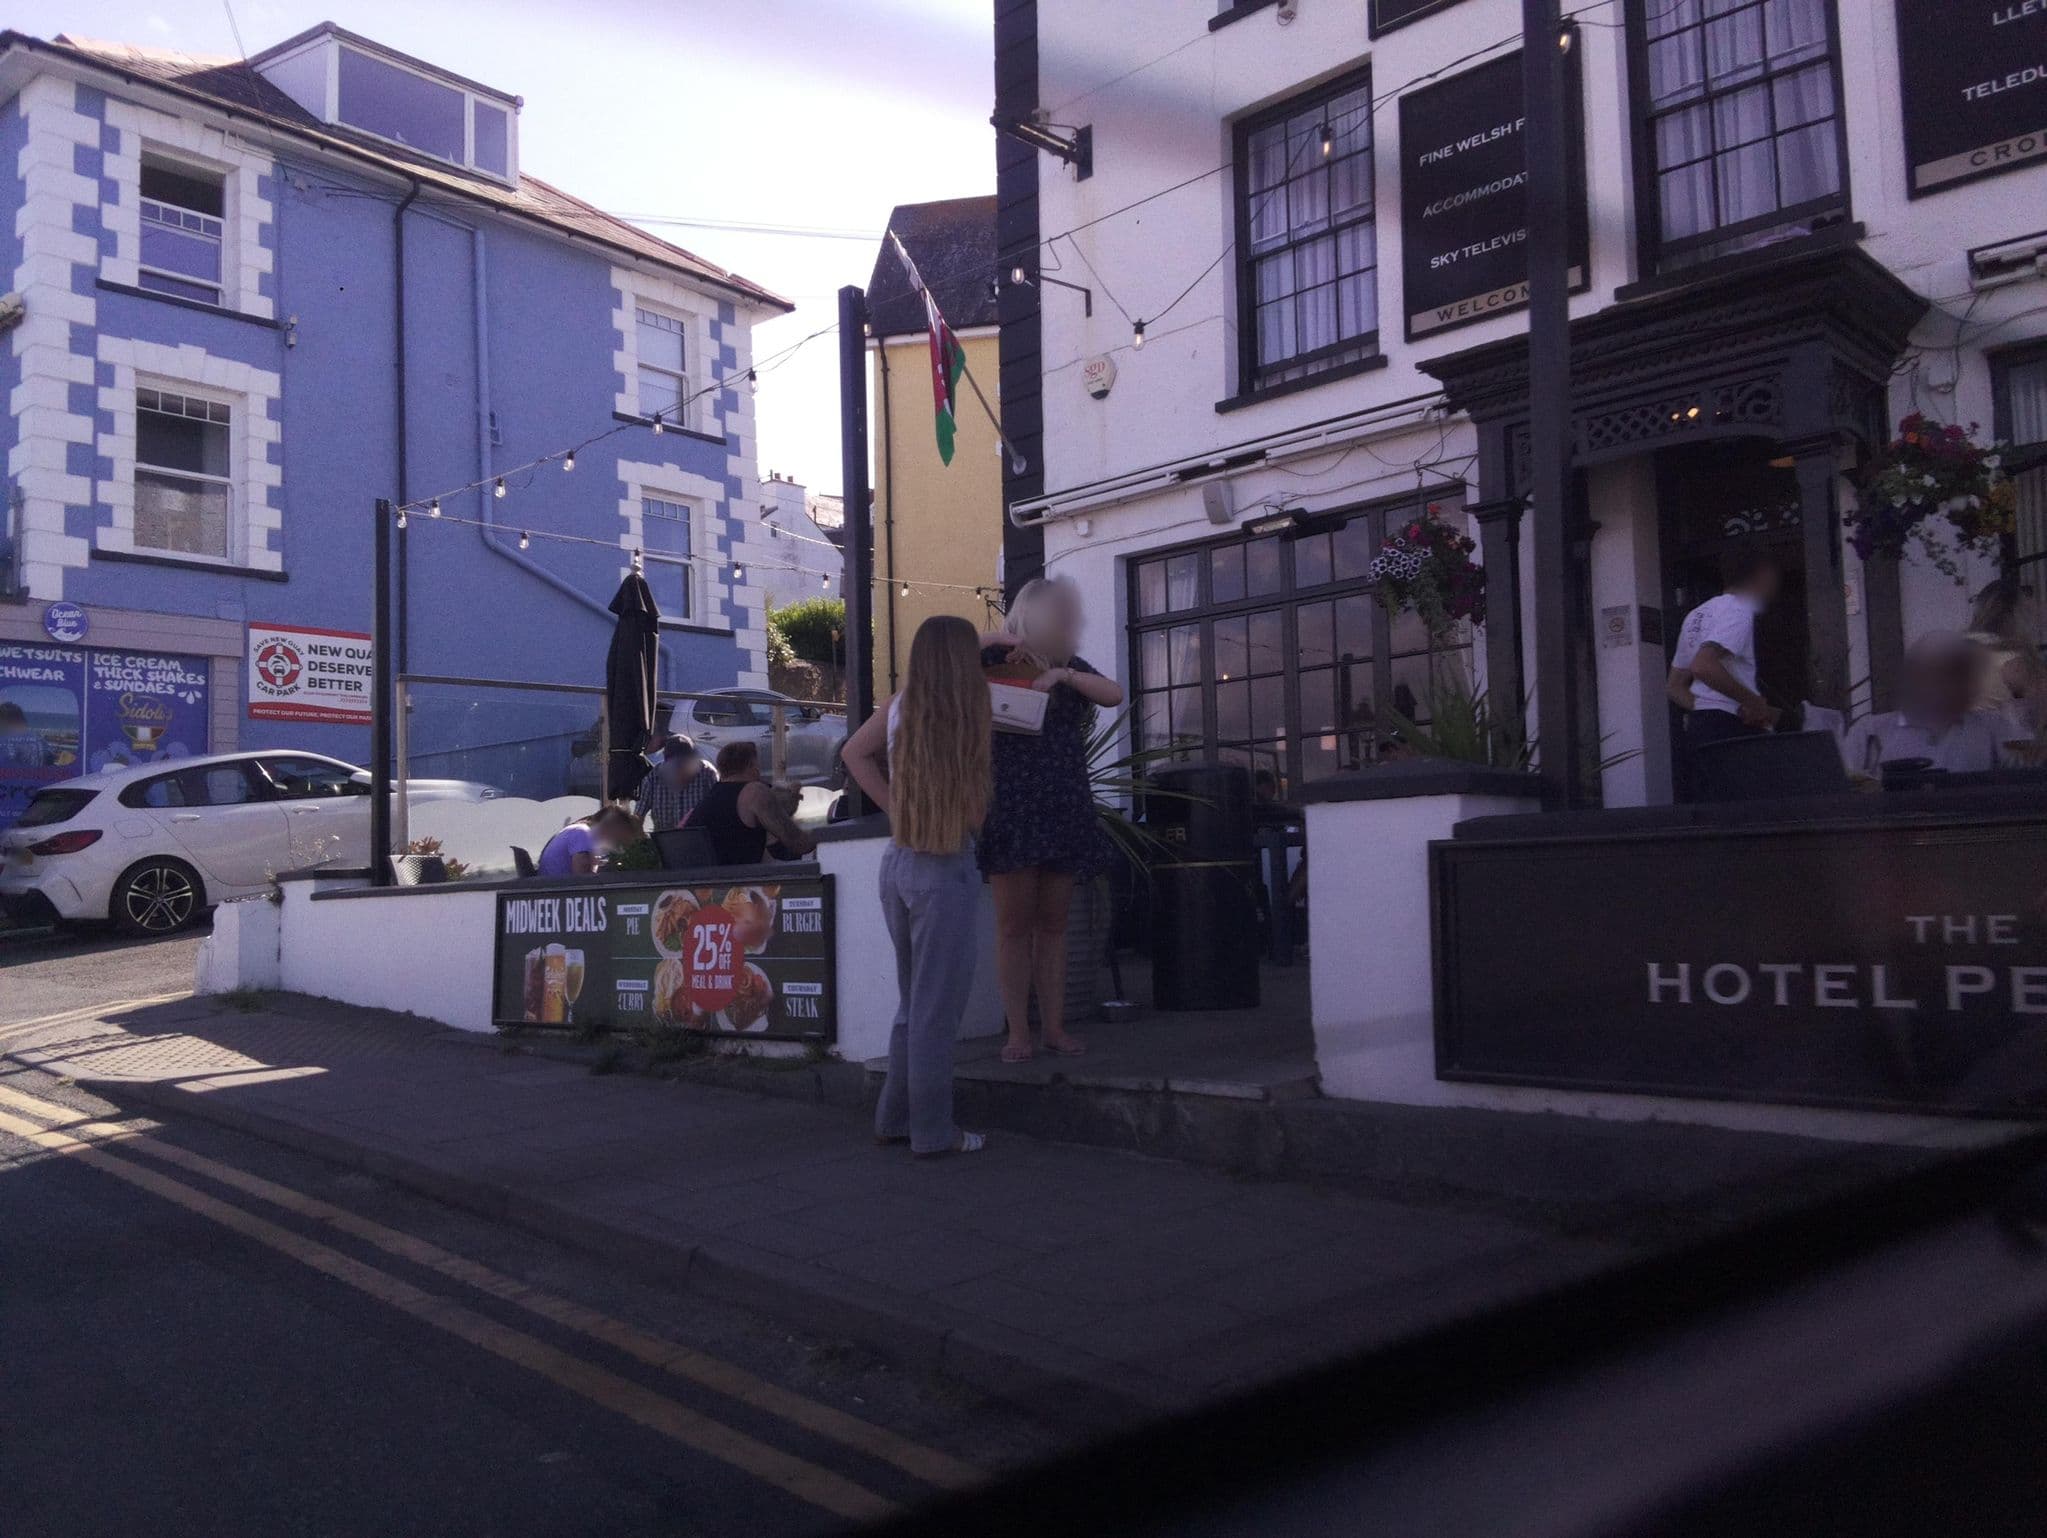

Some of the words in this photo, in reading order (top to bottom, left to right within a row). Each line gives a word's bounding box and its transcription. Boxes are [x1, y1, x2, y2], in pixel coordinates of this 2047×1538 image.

[1992, 0, 2047, 25] LLE
[1419, 145, 1453, 167] FINE
[1456, 122, 1512, 154] WELSH
[1515, 117, 1526, 131] F
[1970, 132, 2047, 166] CRO
[1430, 249, 1460, 269] SKY
[1462, 229, 1527, 258] TELEVIS
[52, 608, 81, 619] Ocean
[0, 646, 82, 663] WETSUITS
[253, 639, 268, 653] SAVE
[288, 640, 304, 656] QUAY
[308, 644, 342, 658] NEW
[94, 653, 121, 667] ICE
[93, 667, 143, 680] THICK
[146, 671, 206, 685] SHAKES
[308, 677, 363, 692] BETTER
[104, 680, 175, 694] SUNDAES
[256, 681, 275, 695] CAR
[276, 683, 301, 696] PARK
[505, 898, 561, 934] MIDWEEK
[566, 896, 607, 932] DEALS
[782, 911, 822, 932] BURGER
[1905, 914, 2018, 944] THE
[718, 953, 731, 970] OFF
[1646, 962, 1918, 1009] HOTEL
[786, 997, 819, 1018] STEAK
